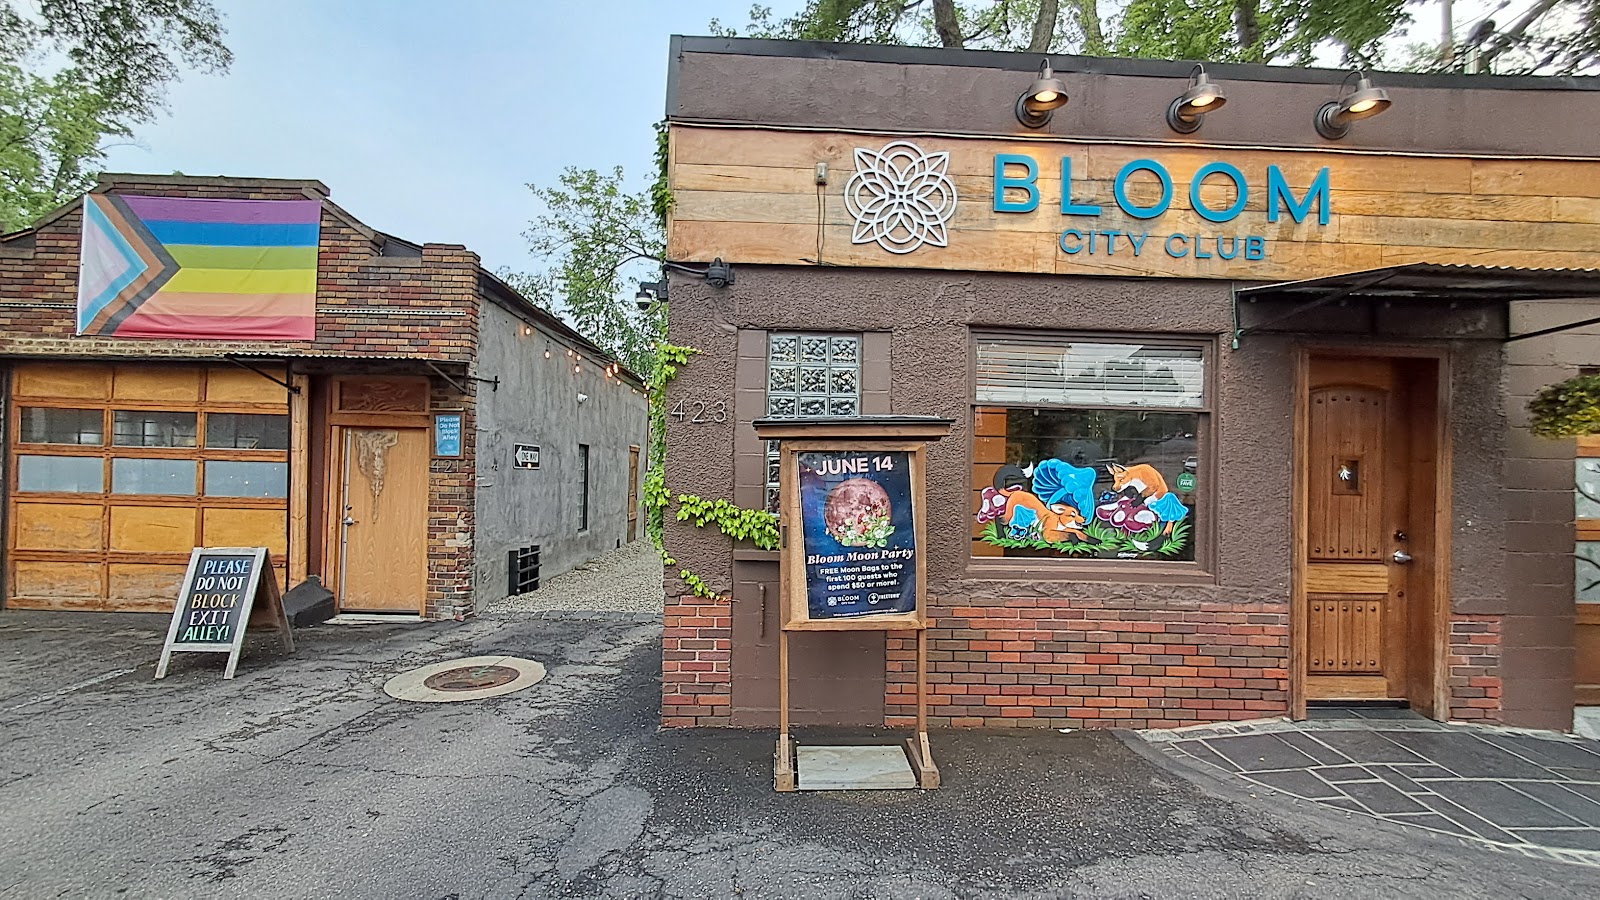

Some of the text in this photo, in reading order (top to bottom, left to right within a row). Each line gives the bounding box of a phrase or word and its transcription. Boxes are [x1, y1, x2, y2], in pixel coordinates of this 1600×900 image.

[993, 153, 1330, 225] BLOOM
[1059, 229, 1266, 261] CITY CLUB
[671, 400, 726, 422] 423
[521, 451, 529, 460] ONE
[431, 460, 459, 472] 421
[816, 456, 893, 475] JUNE 14
[807, 549, 914, 565] Bloom Moon Party
[203, 560, 251, 574] PLEASE
[196, 576, 246, 590] DO NOT
[857, 573, 882, 582] guests
[828, 583, 850, 591] spend
[851, 581, 865, 589] $50
[191, 593, 241, 608] BLOCK
[189, 610, 232, 625] EXIT
[182, 625, 230, 641] ALLEY!
